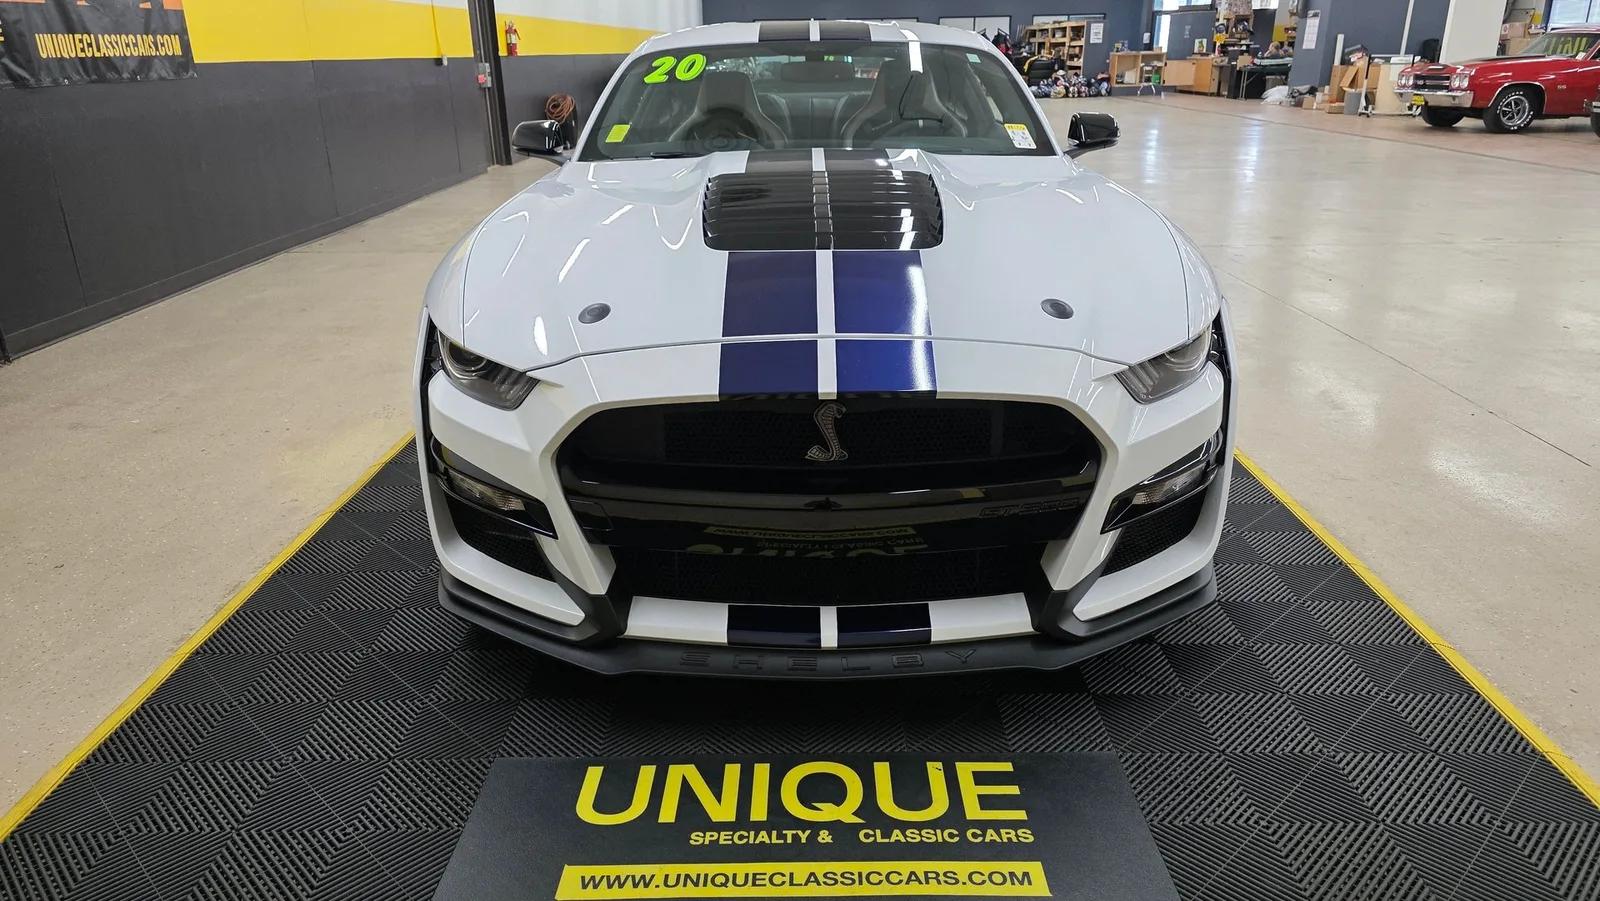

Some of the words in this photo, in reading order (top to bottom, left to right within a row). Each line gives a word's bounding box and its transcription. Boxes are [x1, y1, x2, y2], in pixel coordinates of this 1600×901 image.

[35, 33, 182, 58] UNIQUECLASSICCARS.COM
[644, 53, 706, 84] 20
[679, 648, 978, 673] SHELBY
[575, 760, 1028, 826] UNIQUE
[689, 829, 810, 845] SPECIALTY
[817, 830, 833, 843] &
[858, 828, 959, 843] CLASSIC
[966, 828, 1035, 842] CARS
[580, 870, 1033, 890] WWW.UNIQUECLASSICCARS.COM
